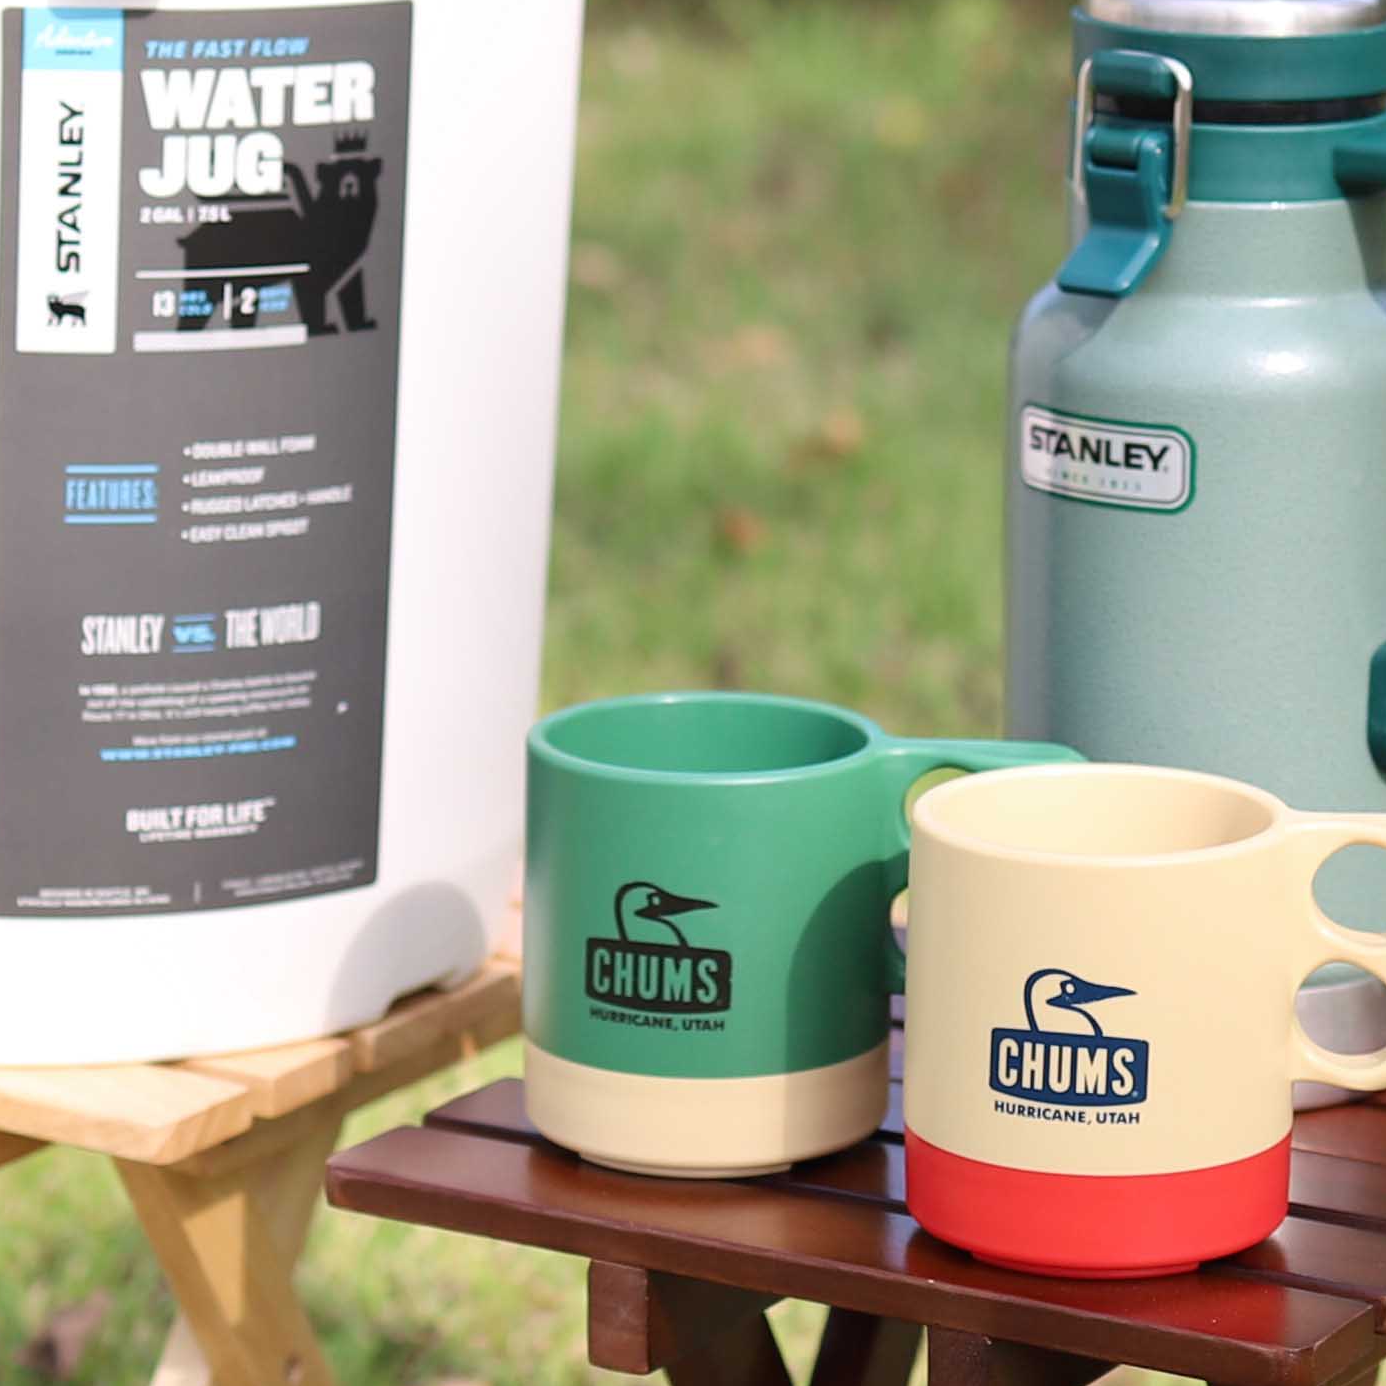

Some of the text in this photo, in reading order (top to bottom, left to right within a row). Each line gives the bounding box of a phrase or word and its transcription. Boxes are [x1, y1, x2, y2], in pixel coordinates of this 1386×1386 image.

[144, 36, 311, 59] THE FAST FLOW
[139, 61, 377, 131] WATER
[138, 131, 286, 198] JUG
[54, 100, 87, 274] STANLEY
[151, 290, 176, 318] 13
[240, 286, 258, 315] 2
[1029, 424, 1170, 472] STANLEY
[65, 478, 157, 511] FEATURES
[189, 525, 223, 543] EASY
[81, 614, 165, 655] STANLEY
[224, 608, 259, 649] THE
[259, 600, 322, 645] WORLD
[125, 807, 183, 832] BUILT
[184, 804, 224, 827] FOR
[592, 948, 719, 1004] CHUMS
[589, 1007, 726, 1032] HURRICANE, UTAH
[997, 1037, 1135, 1097] CHUMS
[994, 1100, 1141, 1126] HURRICANE, UTAH
